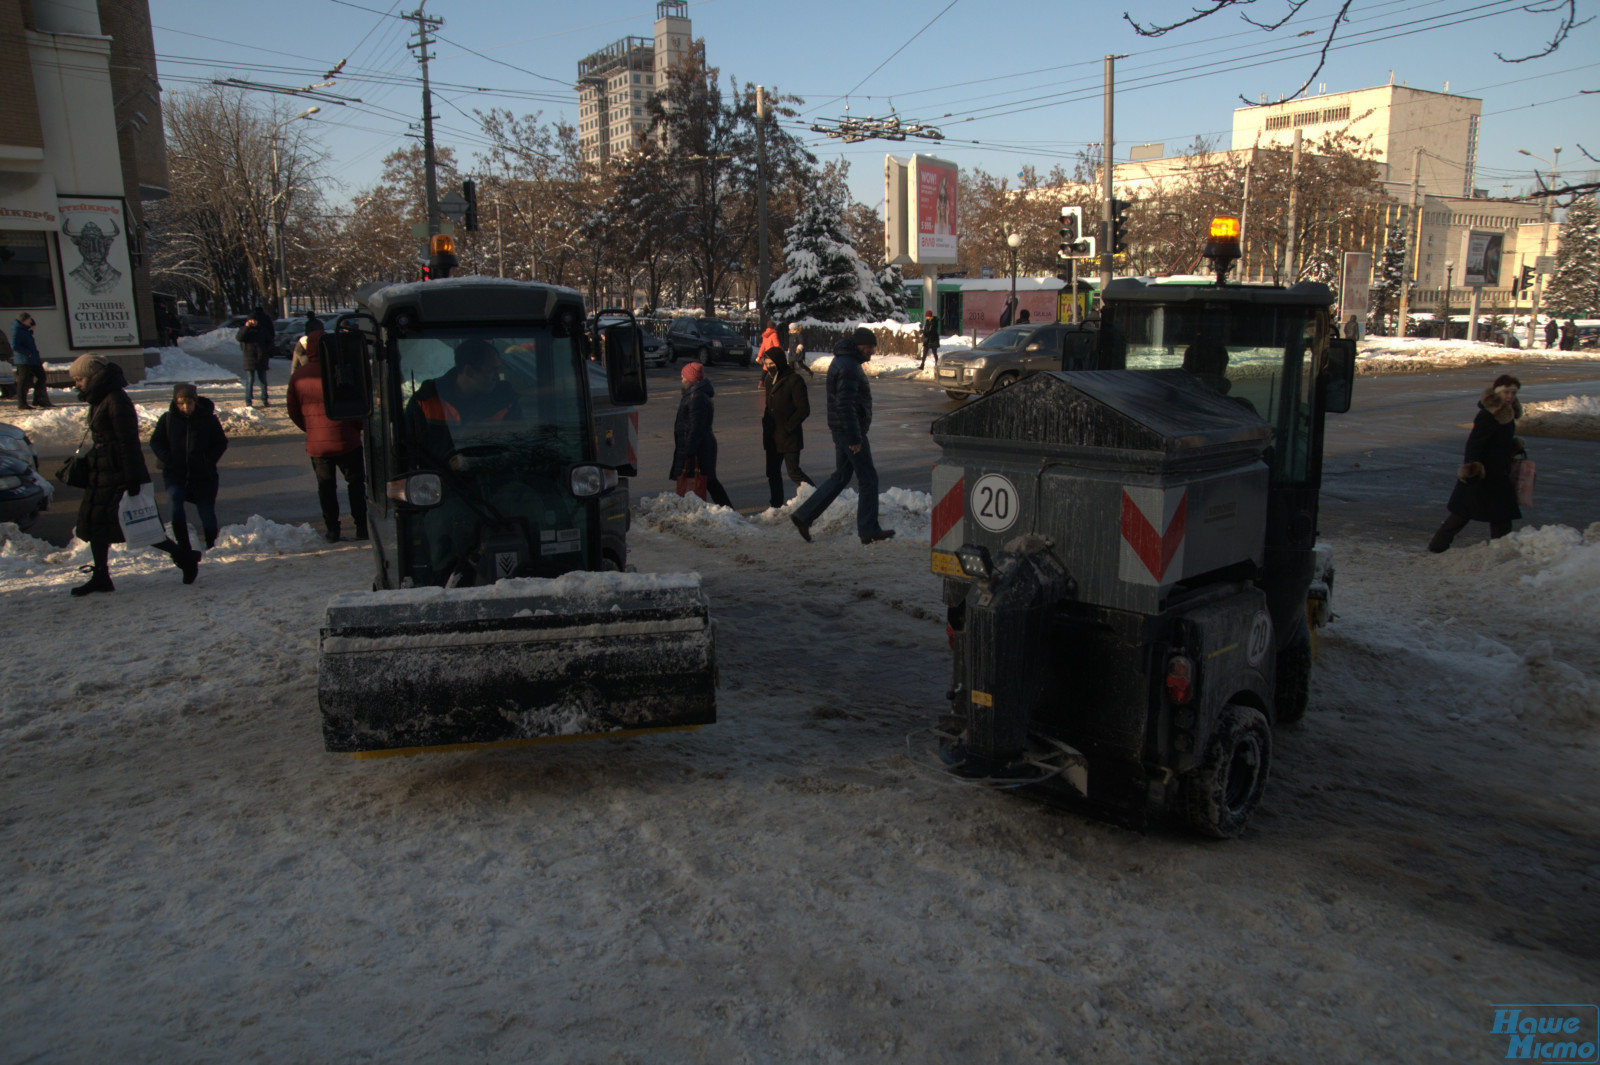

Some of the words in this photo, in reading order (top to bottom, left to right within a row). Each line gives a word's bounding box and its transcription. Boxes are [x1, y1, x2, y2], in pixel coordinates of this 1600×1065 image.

[77, 302, 126, 310] ЛУЧШИЕ
[74, 310, 130, 321] СТЕЙКИ
[968, 311, 985, 321] 2018
[80, 322, 87, 330] В
[88, 321, 128, 330] ГОРОДЕ
[980, 486, 1009, 519] 20
[1251, 621, 1268, 657] 20
